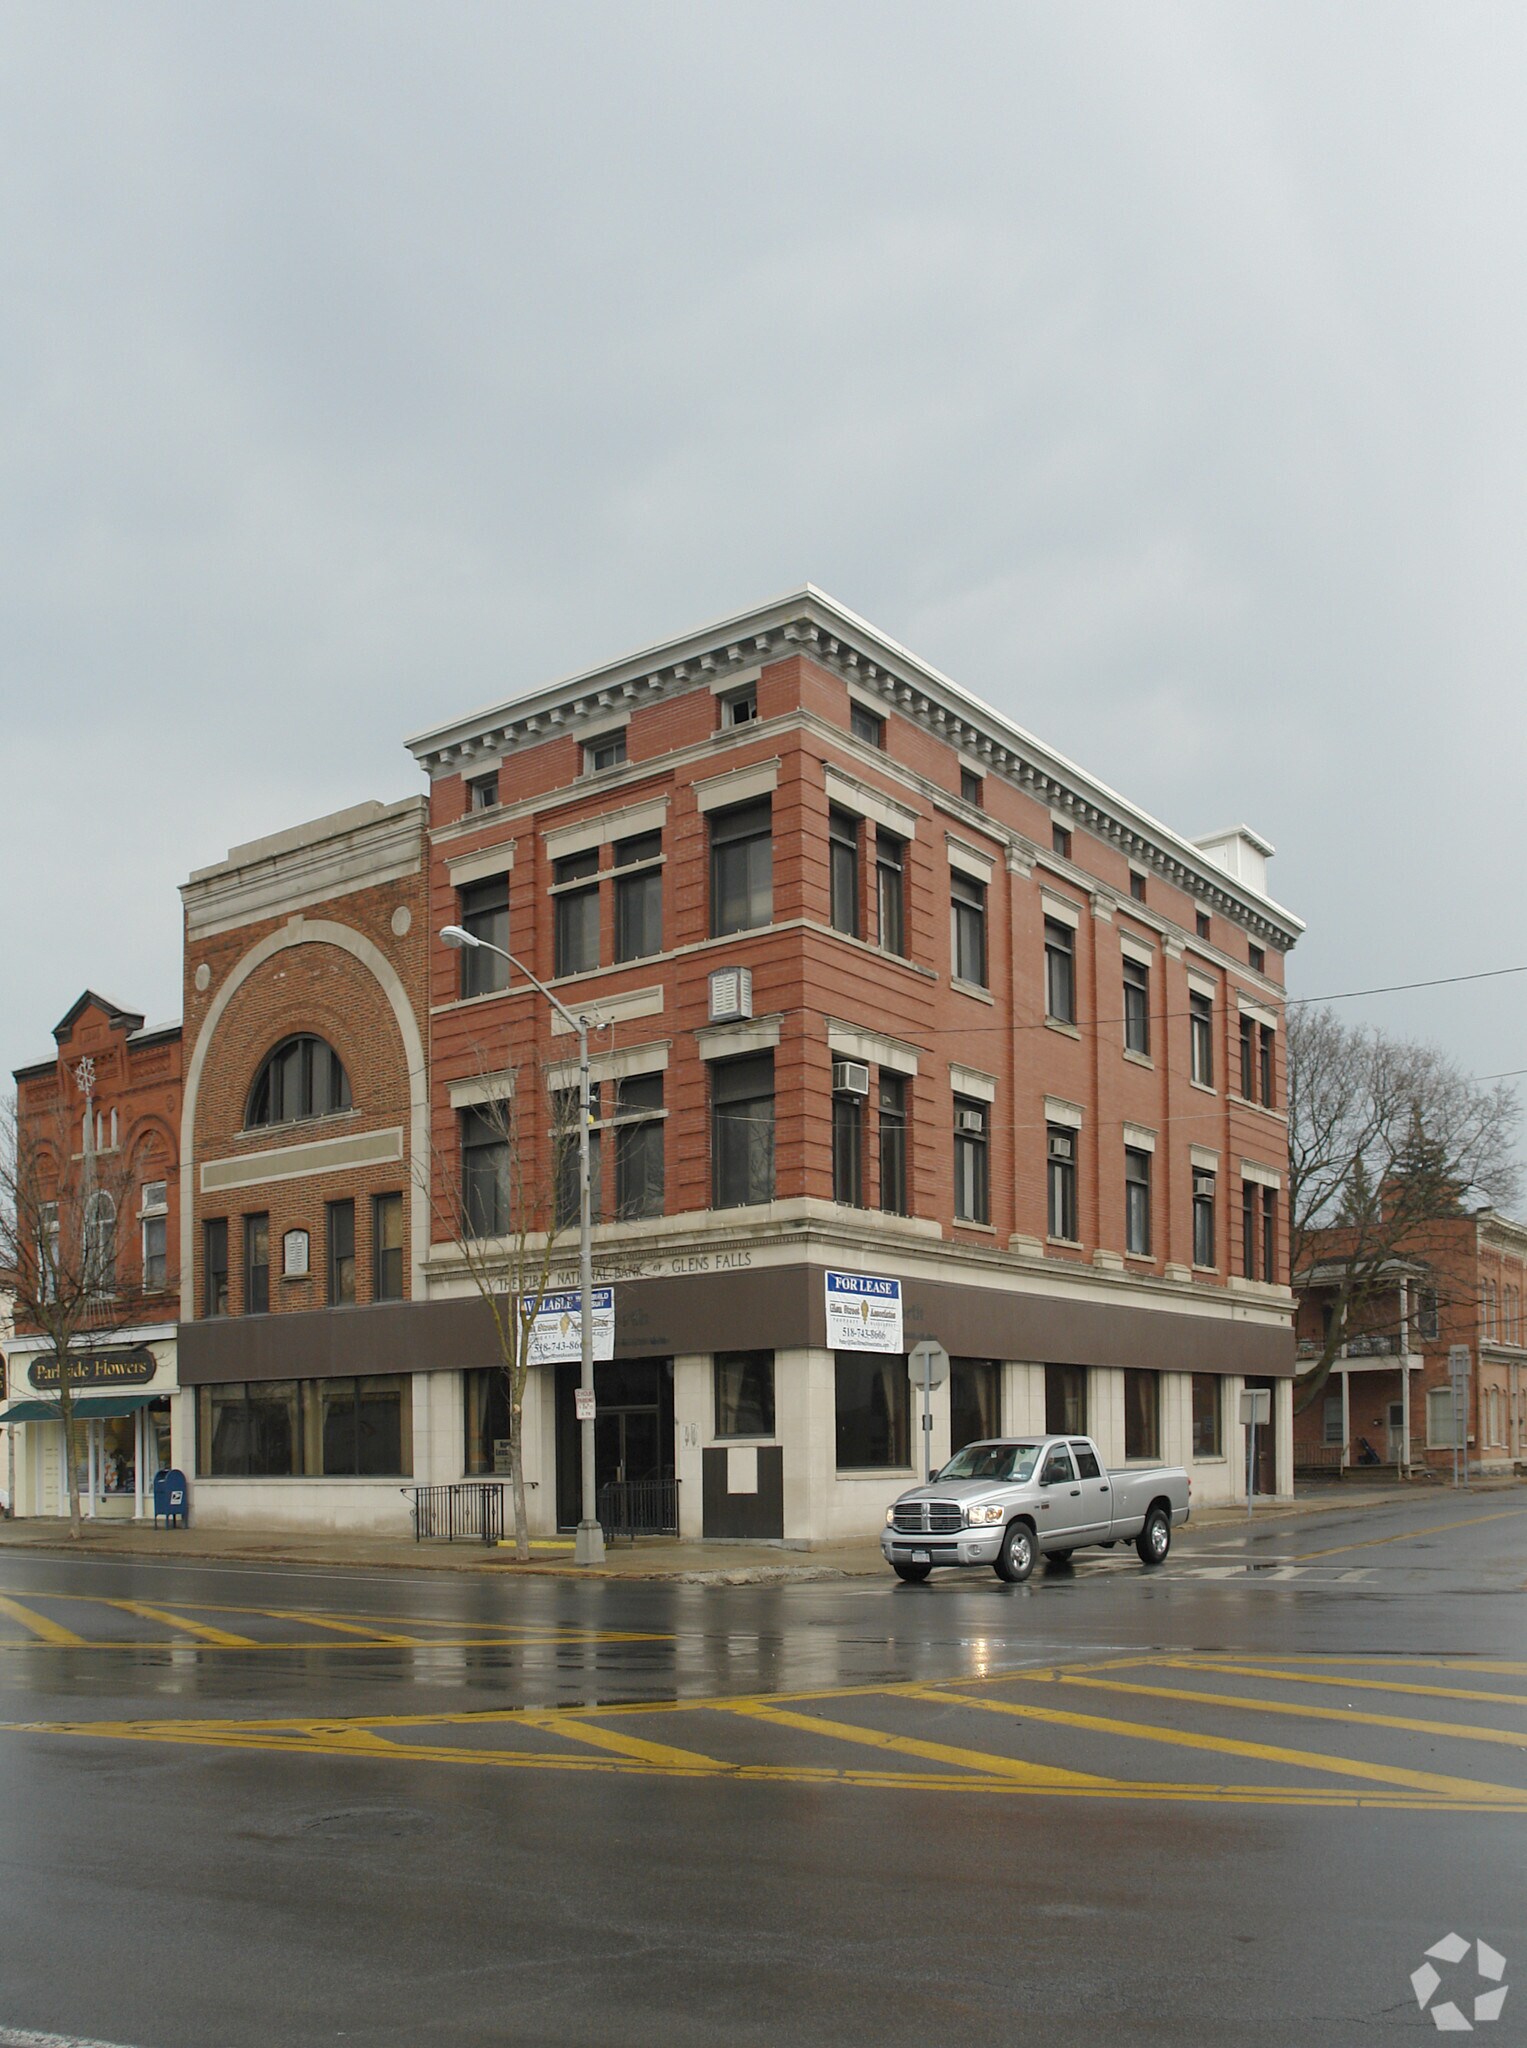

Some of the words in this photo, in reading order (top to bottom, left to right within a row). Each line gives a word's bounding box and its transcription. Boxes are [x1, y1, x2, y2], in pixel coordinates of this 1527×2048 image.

[497, 1276, 518, 1291] THE
[523, 1273, 550, 1289] FIRT
[557, 1265, 609, 1285] NATINAL
[671, 1256, 709, 1273] GLENS
[715, 1252, 752, 1269] FALLS
[835, 1276, 858, 1291] FOR
[860, 1279, 892, 1295] LEASE
[522, 1296, 573, 1313] AVILABLE
[36, 1361, 89, 1380] Paride
[94, 1359, 147, 1377] Flowers
